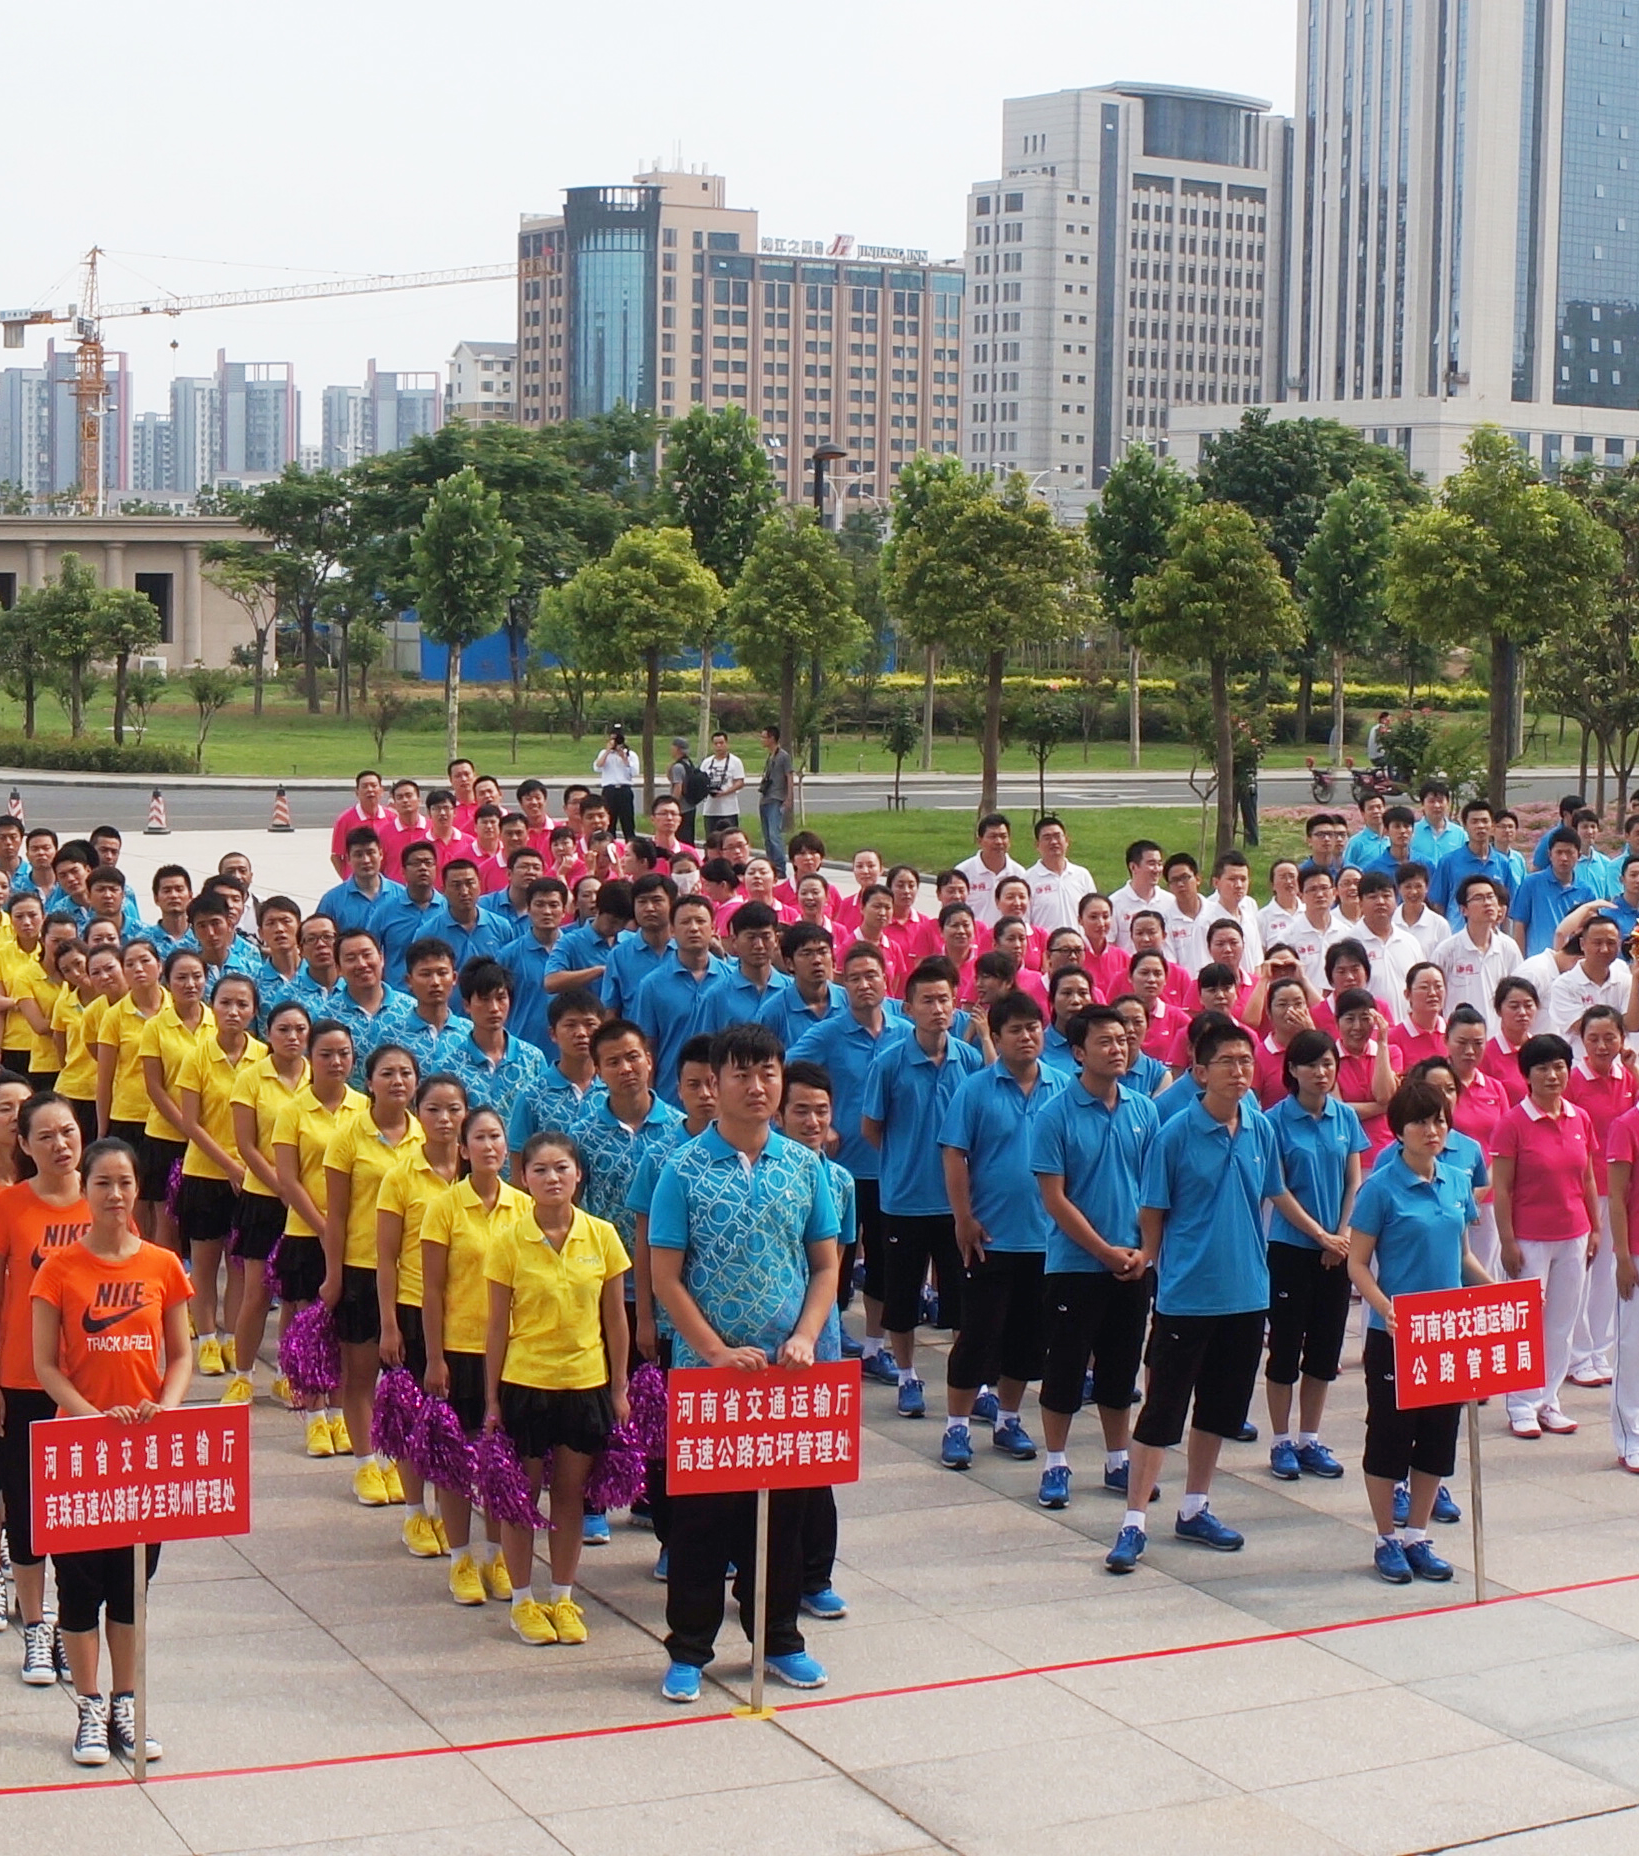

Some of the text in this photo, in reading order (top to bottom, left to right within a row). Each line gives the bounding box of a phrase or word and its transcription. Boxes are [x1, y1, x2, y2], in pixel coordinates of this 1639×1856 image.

[857, 244, 929, 262] JINJIANG INN
[94, 1281, 145, 1308] NIKE
[1410, 1300, 1530, 1344] 河南省交通运输厅
[87, 1336, 121, 1351] TRACK
[1413, 1340, 1533, 1386] 公路管理局
[676, 1384, 853, 1425] 河南省交通运输厅
[44, 1429, 236, 1480] 河南省交通运输厅
[676, 1428, 853, 1472] 高速公路宛坪管理处
